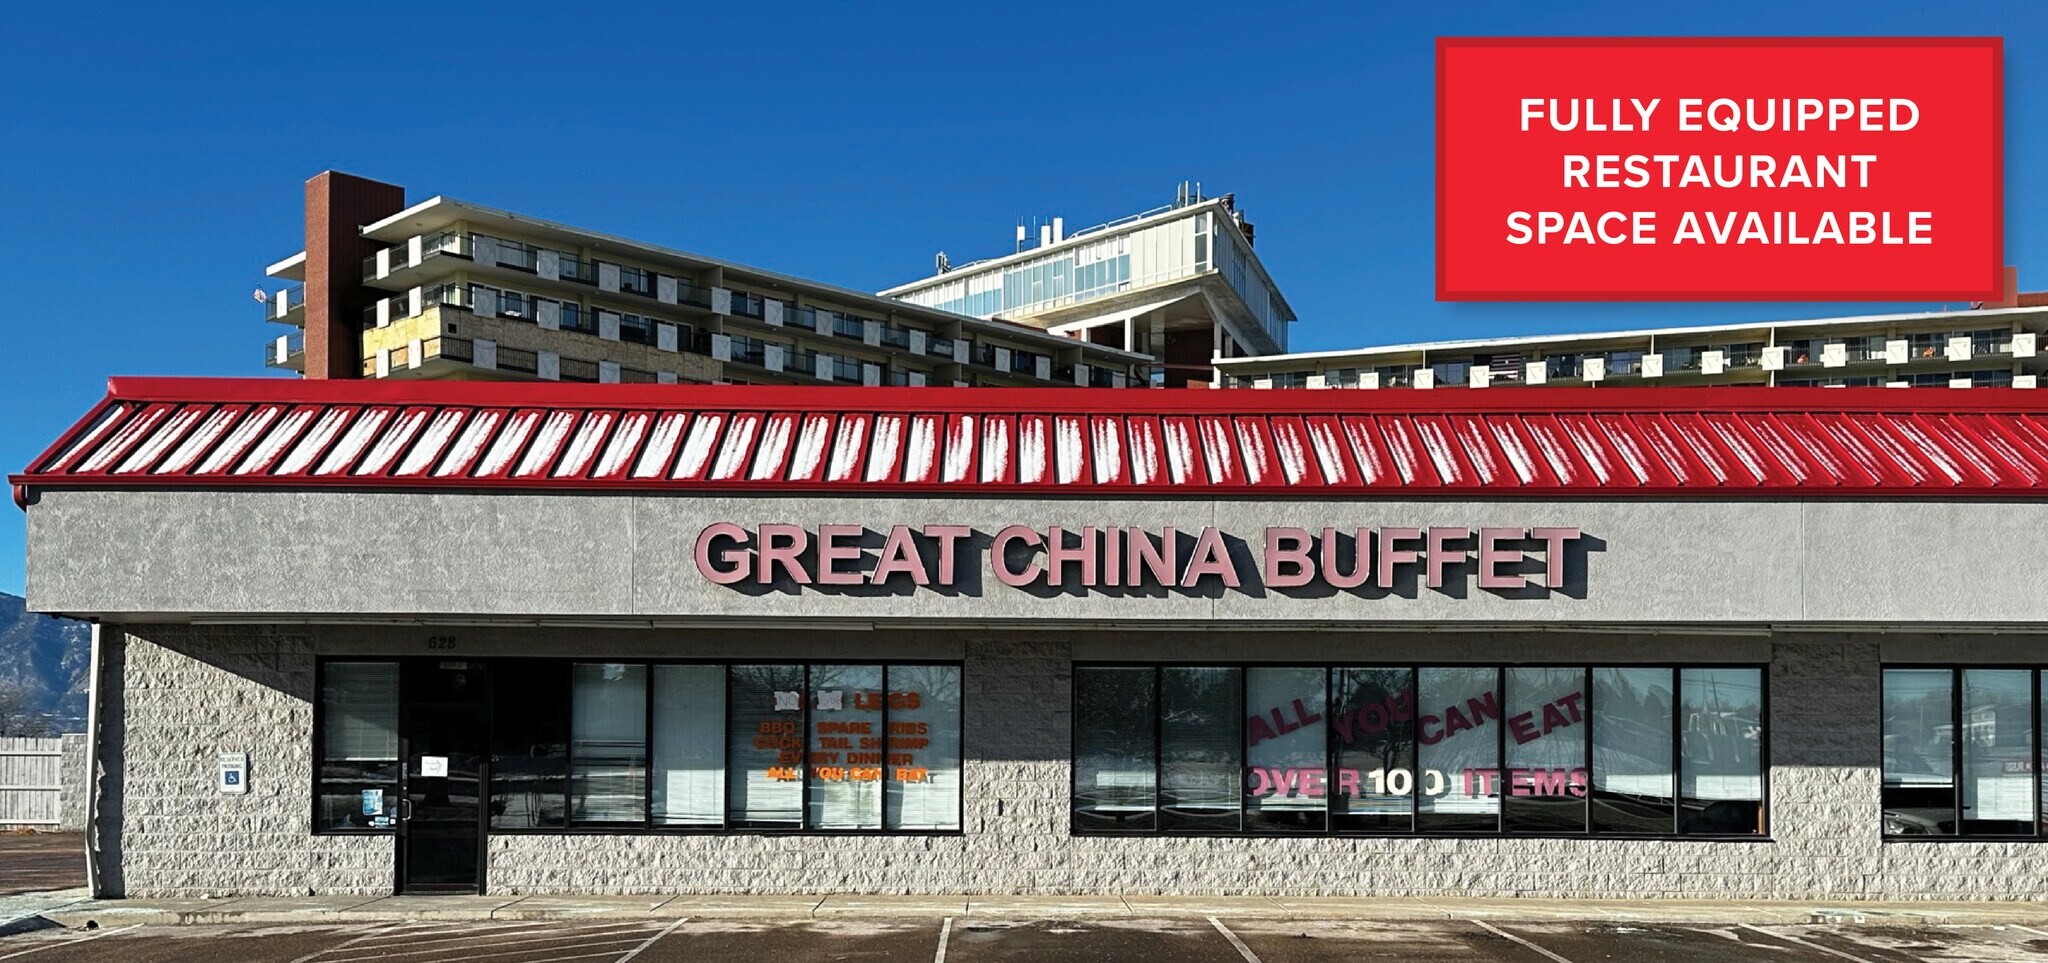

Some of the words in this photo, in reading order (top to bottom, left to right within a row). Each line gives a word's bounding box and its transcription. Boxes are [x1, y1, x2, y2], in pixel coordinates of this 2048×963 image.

[694, 522, 971, 586] GREAT
[990, 524, 1240, 588] CHINA
[1264, 526, 1581, 588] BUFFET
[428, 636, 456, 649] 628
[854, 692, 921, 711] LEGS
[1248, 698, 1322, 747] ALL
[1332, 688, 1412, 744] YOU
[1417, 691, 1499, 745] CAN
[1508, 692, 1582, 745] EAT
[760, 721, 796, 735] BBQ
[817, 721, 871, 735] SPARE
[887, 721, 928, 735] RIBS
[819, 736, 853, 749] TAIL
[859, 736, 929, 750] SHRIMP
[779, 750, 840, 764] EVERY
[767, 766, 798, 779] ALL
[810, 766, 844, 780] YOU
[896, 767, 928, 781] EAT
[1247, 765, 1361, 798] OVER
[1463, 768, 1589, 797] ITEMS
